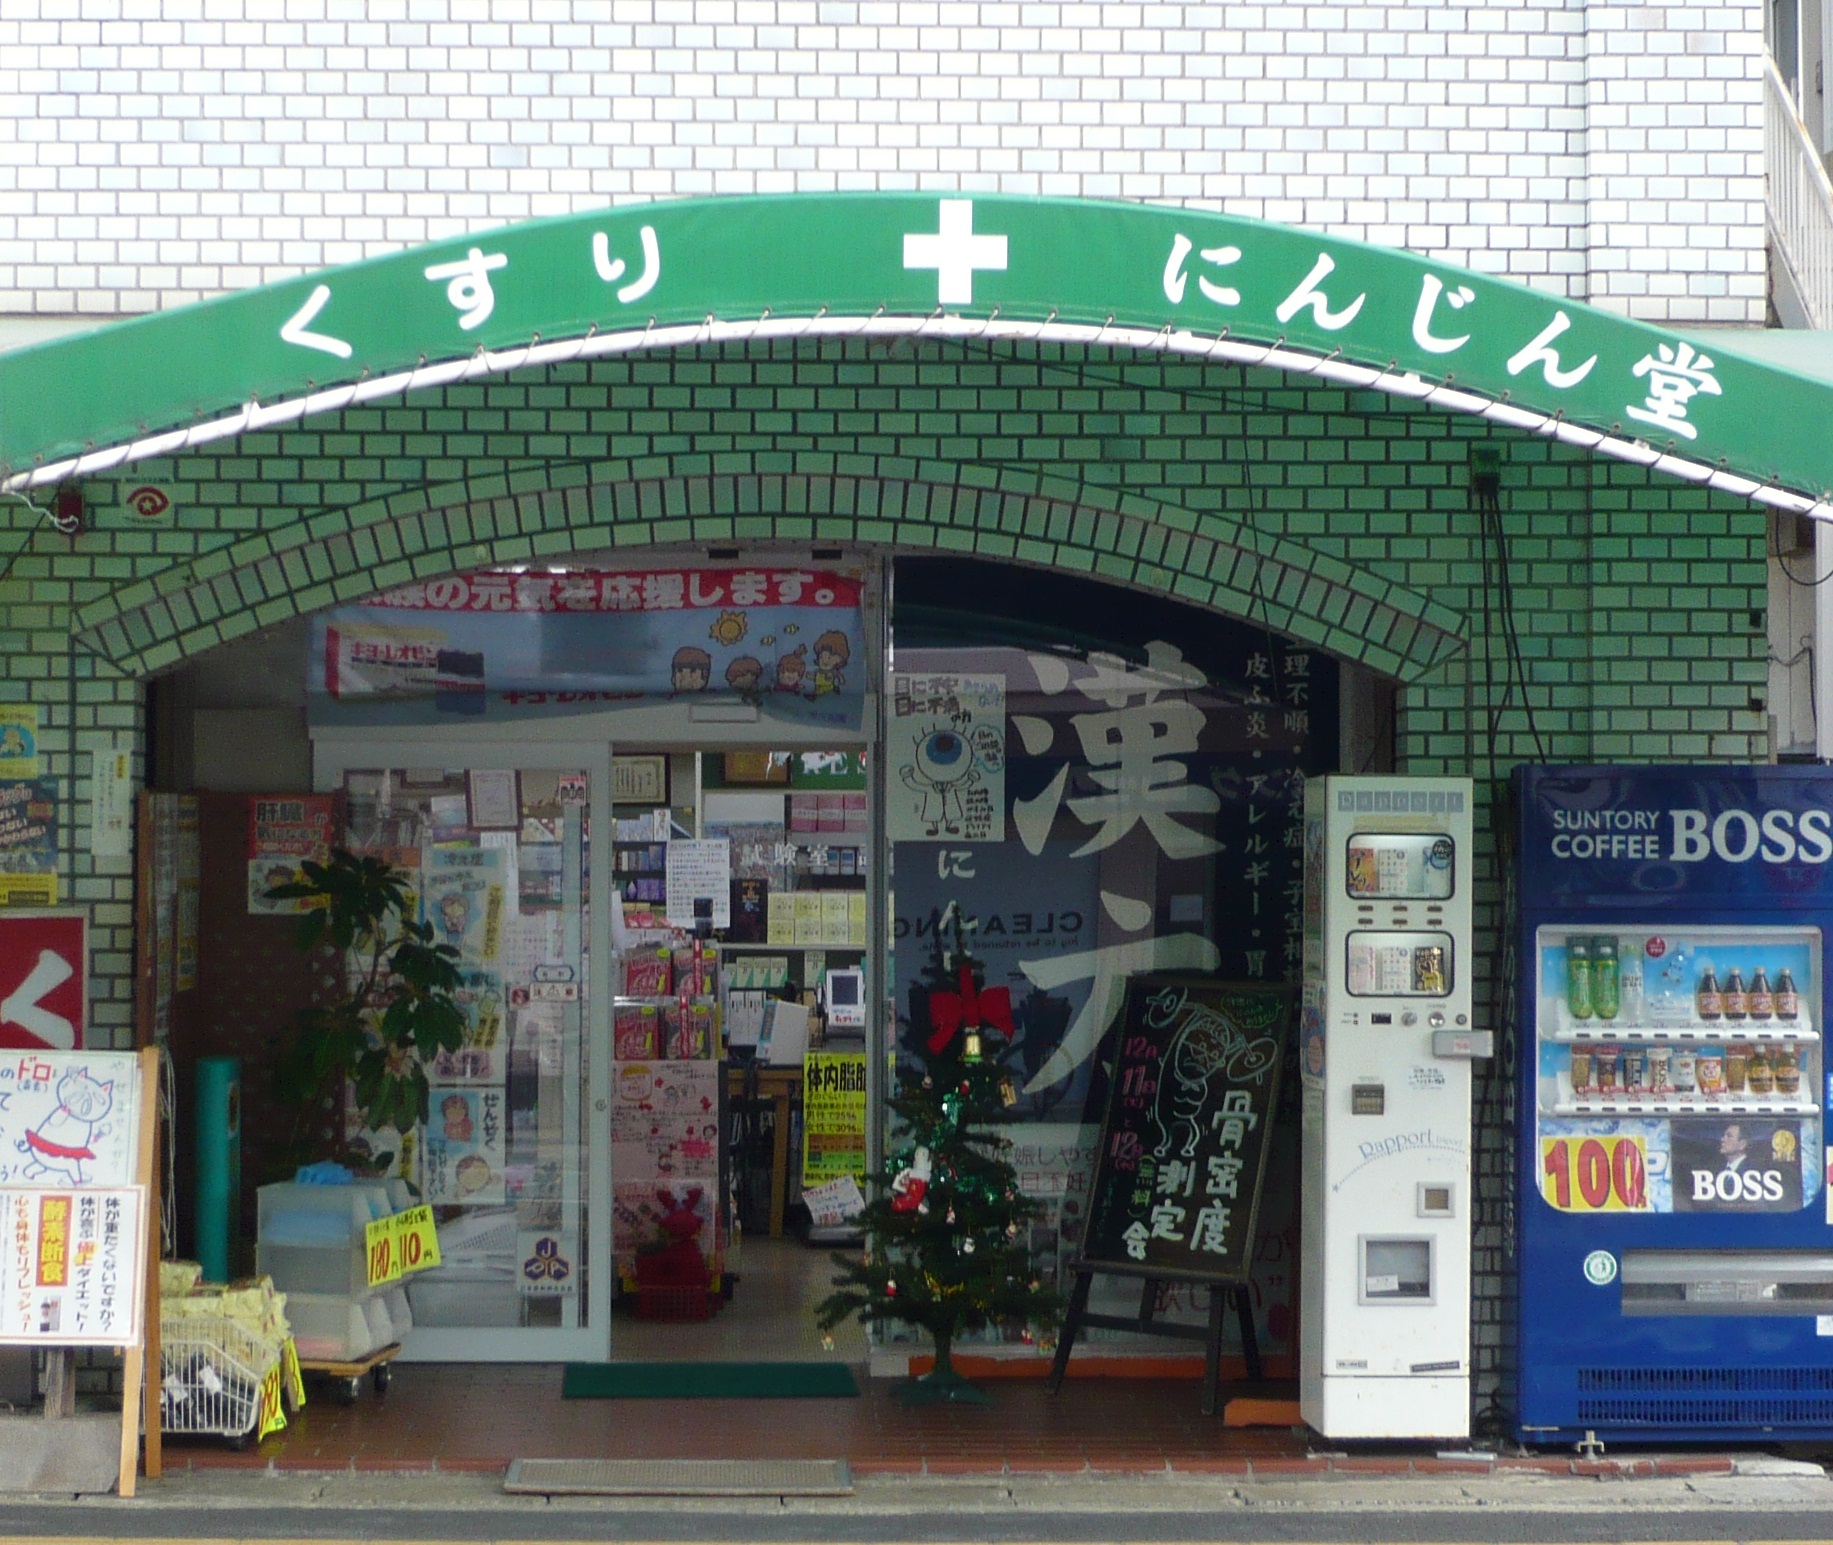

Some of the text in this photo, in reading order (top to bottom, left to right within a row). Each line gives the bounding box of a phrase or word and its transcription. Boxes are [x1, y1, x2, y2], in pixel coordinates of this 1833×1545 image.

[281, 226, 661, 358] くすり
[1162, 233, 1722, 439] にんじん堂
[1551, 808, 1832, 864] COFFEE BOSS
[1553, 810, 1660, 830] SUNTORY
[1, 949, 75, 1050] く
[1190, 1090, 1258, 1254] 骨密度
[1358, 1129, 1433, 1160] Rapport
[1545, 1139, 1646, 1208] 100
[1692, 1170, 1783, 1201] BOSS
[1121, 1220, 1151, 1261] 会
